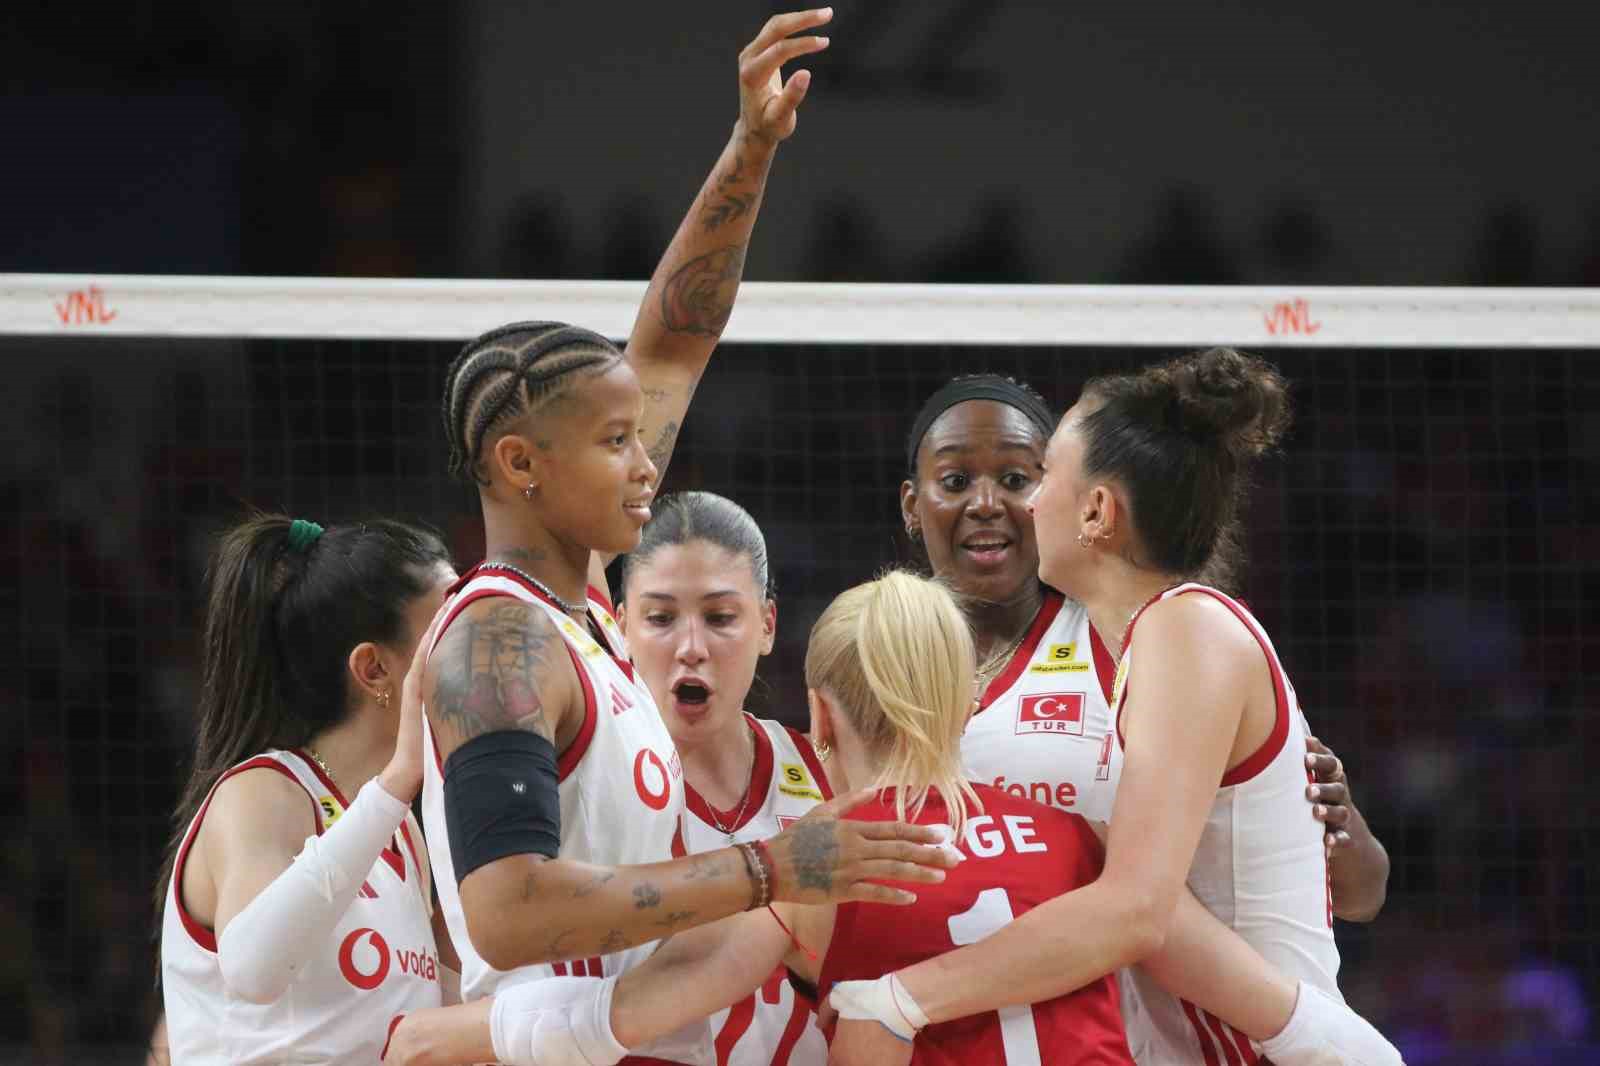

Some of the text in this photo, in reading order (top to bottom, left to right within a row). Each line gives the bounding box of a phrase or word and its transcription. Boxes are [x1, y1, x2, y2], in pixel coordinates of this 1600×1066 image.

[54, 285, 119, 326] VNL
[1263, 297, 1323, 336] VNL
[1055, 647, 1071, 659] S
[1031, 721, 1067, 731] TUR
[787, 768, 803, 782] S
[396, 946, 438, 981] voda
